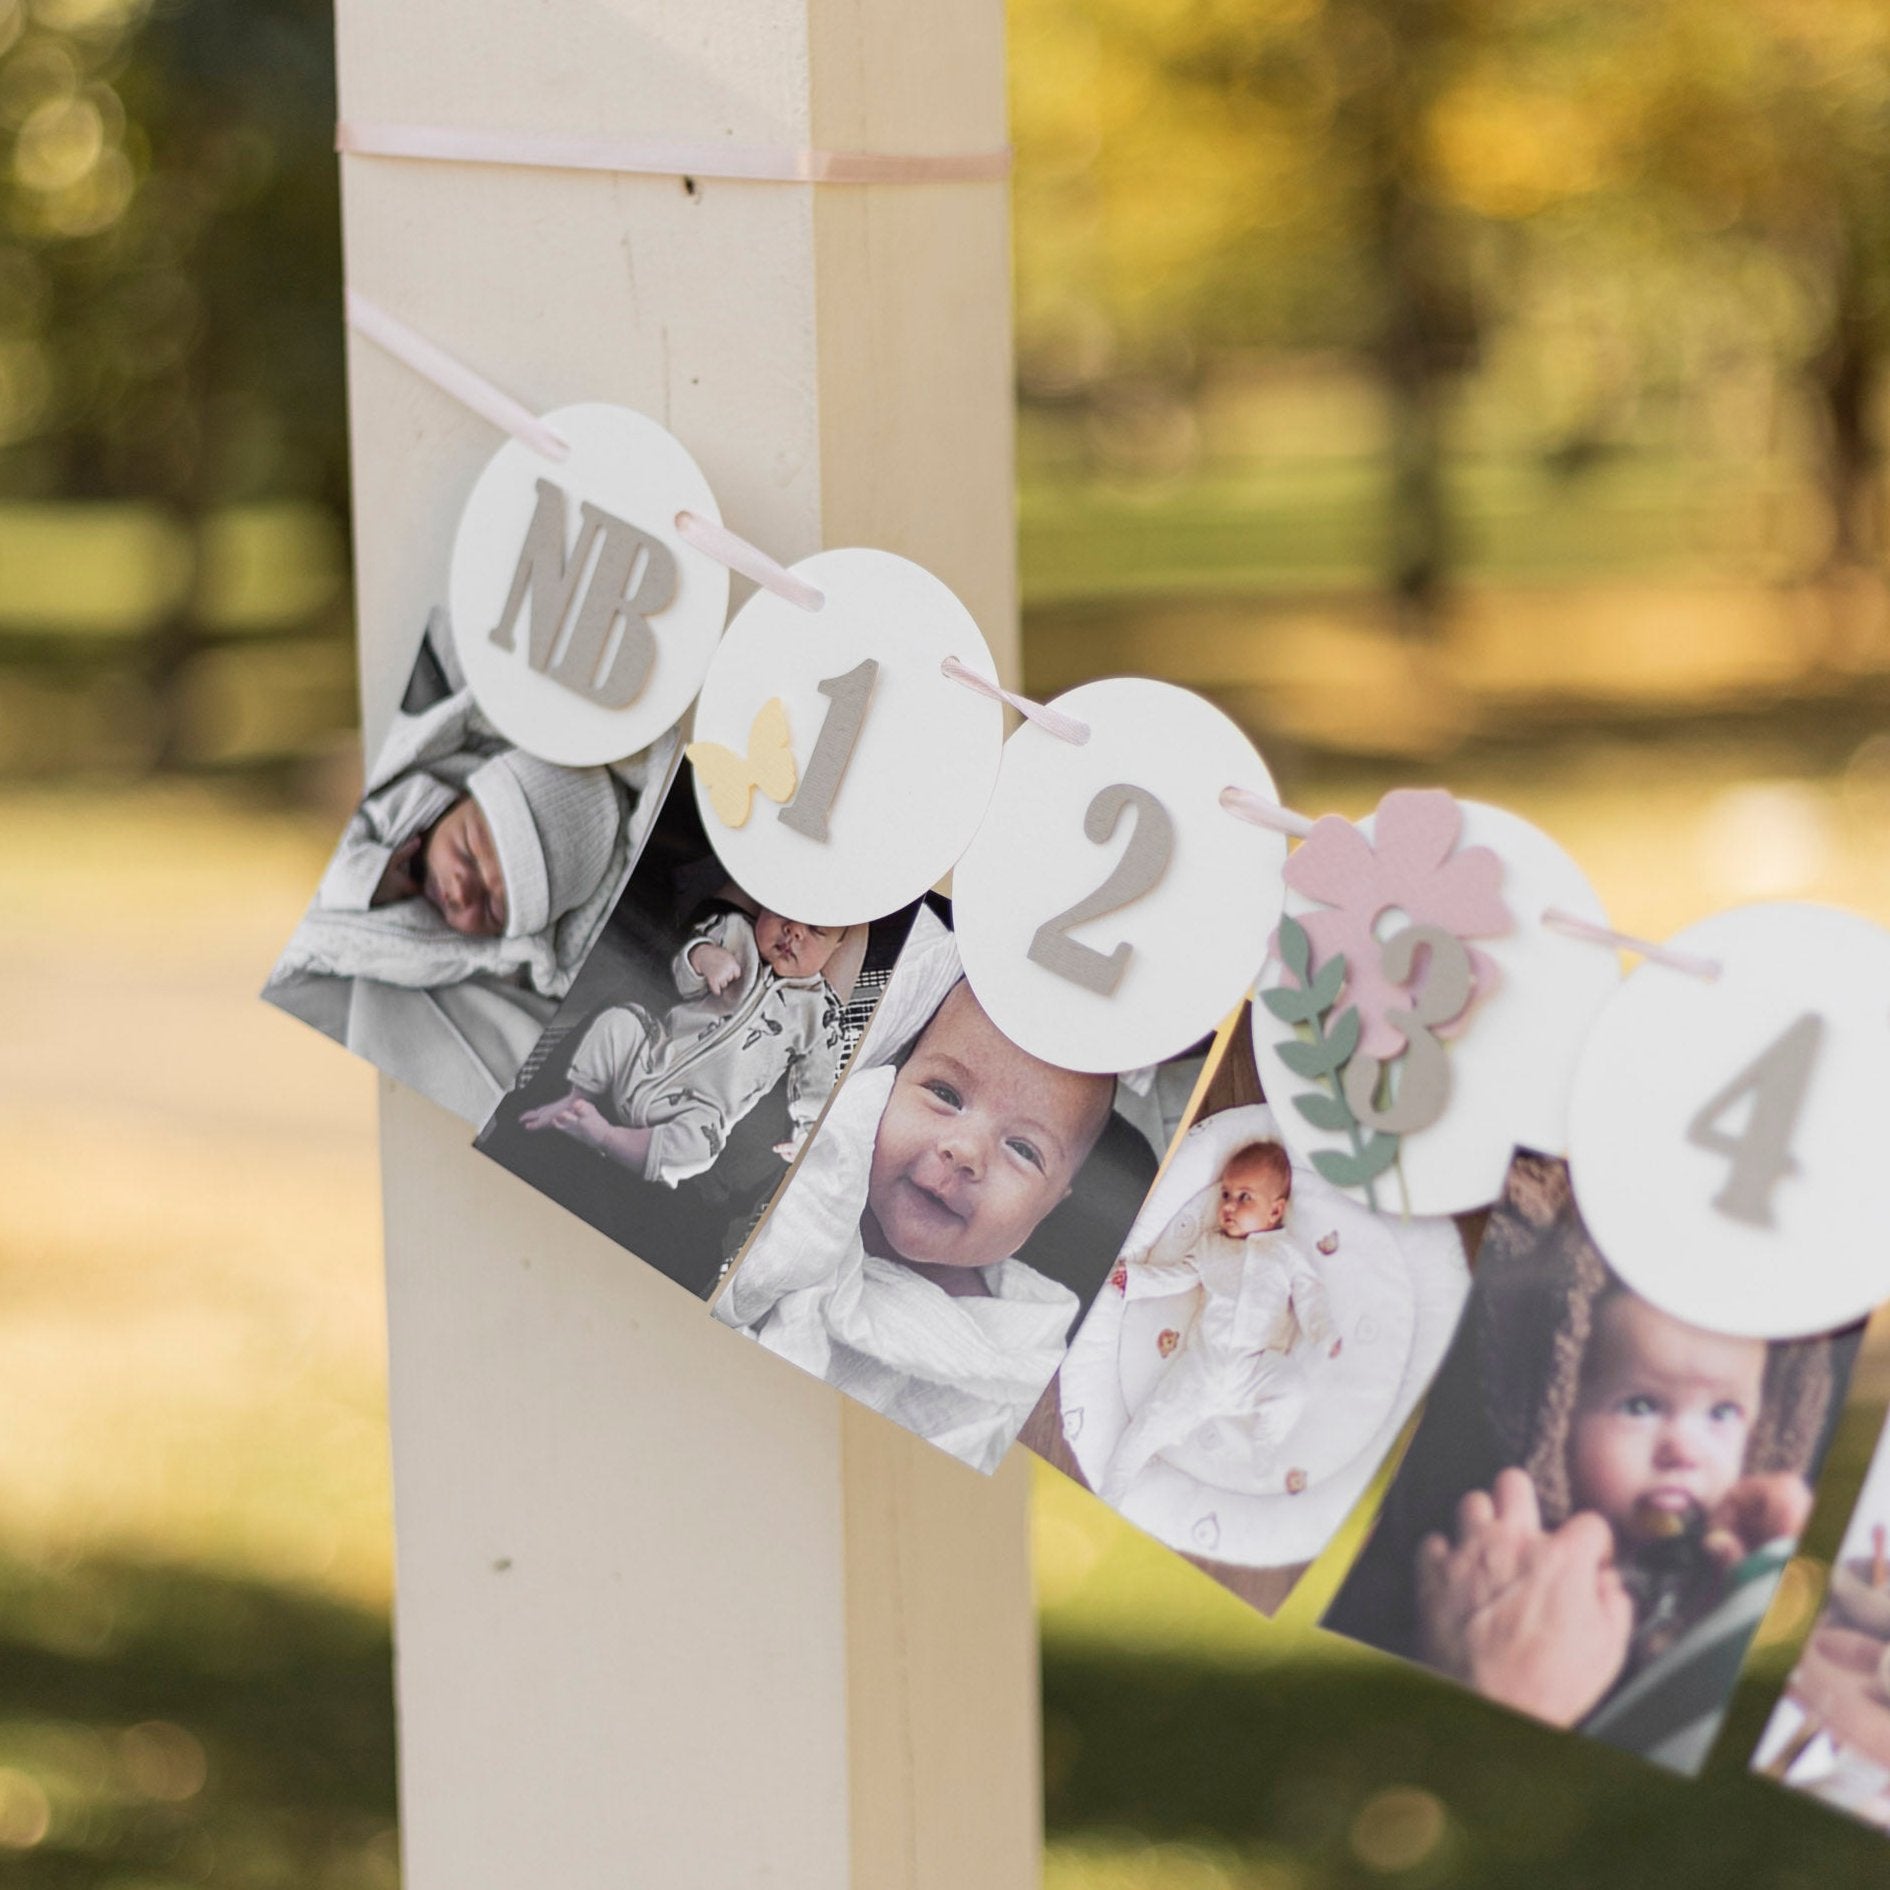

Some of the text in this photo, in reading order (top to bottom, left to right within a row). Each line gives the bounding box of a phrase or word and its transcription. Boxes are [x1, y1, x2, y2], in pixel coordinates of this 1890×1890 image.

[488, 477, 680, 711] NB
[778, 658, 879, 844] 1
[1027, 783, 1173, 998] 2
[1344, 925, 1470, 1134] 3
[1686, 1011, 1824, 1231] 4
